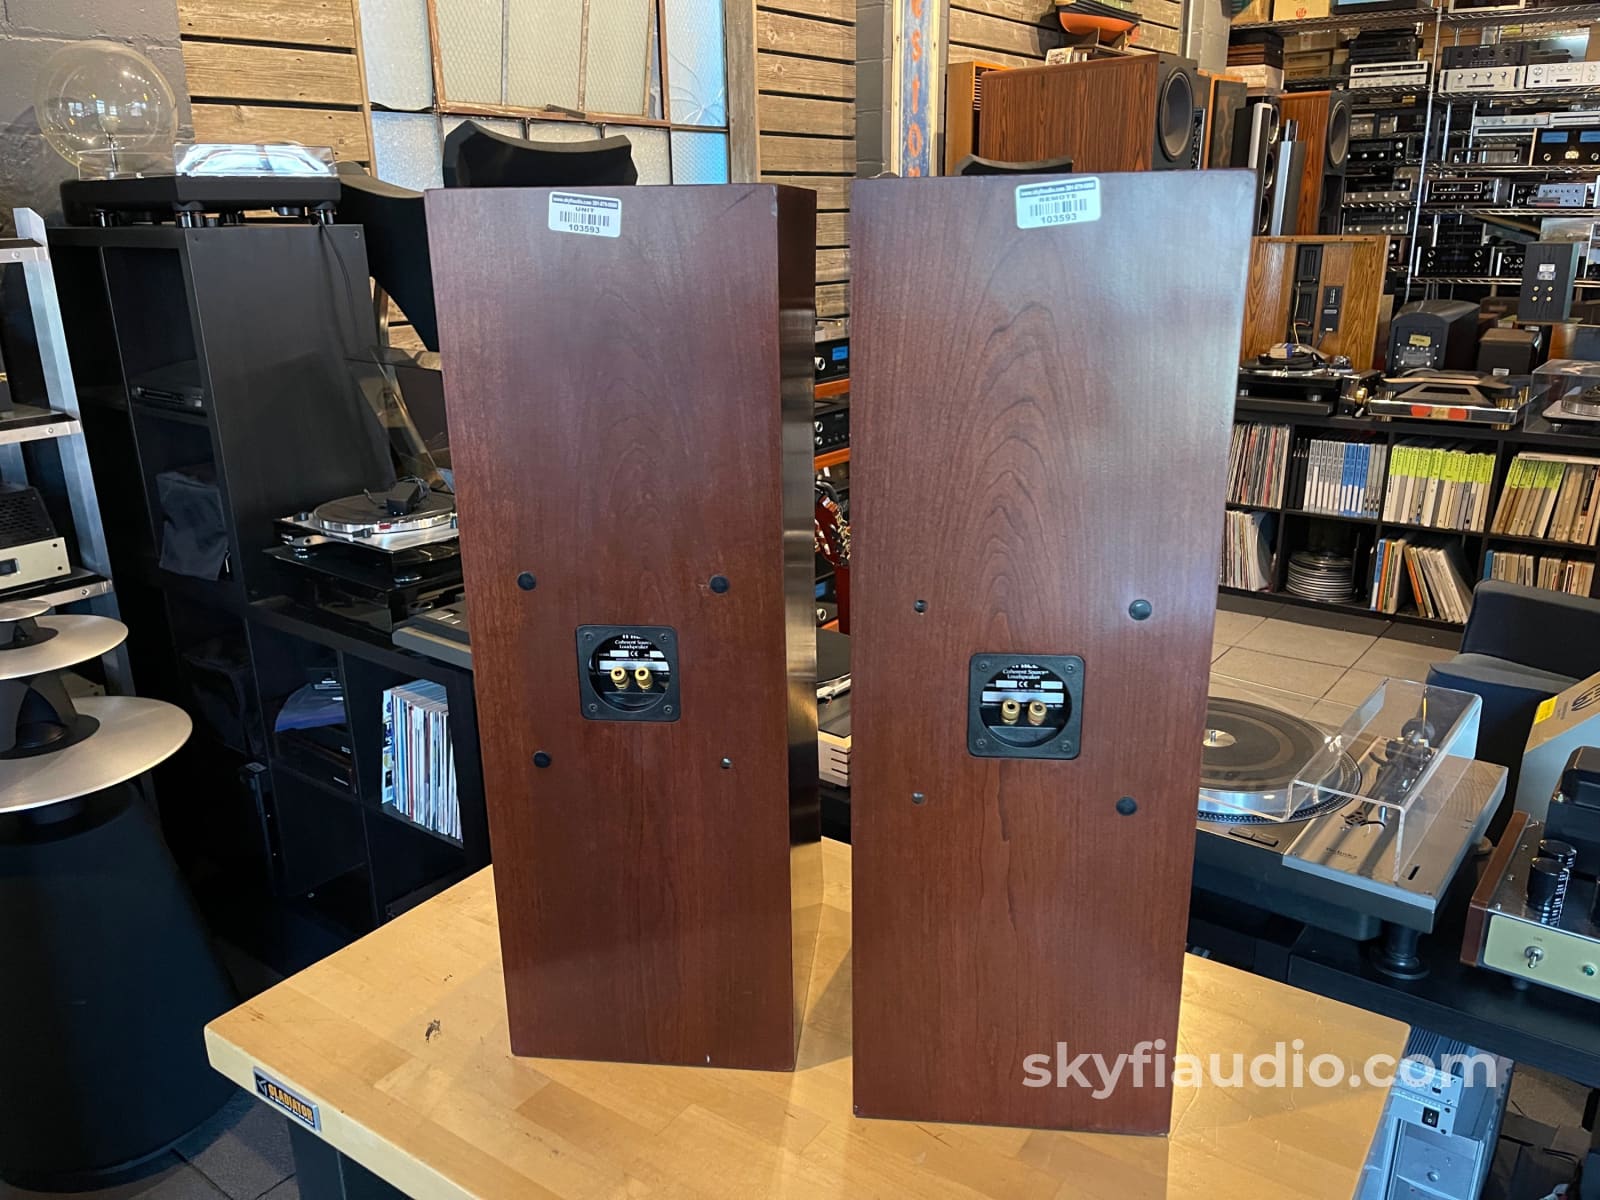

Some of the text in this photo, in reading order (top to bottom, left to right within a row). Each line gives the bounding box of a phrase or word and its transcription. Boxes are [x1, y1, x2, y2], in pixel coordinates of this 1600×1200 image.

[1039, 193, 1077, 202] REMOTE
[1041, 213, 1077, 224] 103593
[568, 224, 600, 233] 103593
[268, 1083, 313, 1121] GLADIATOR
